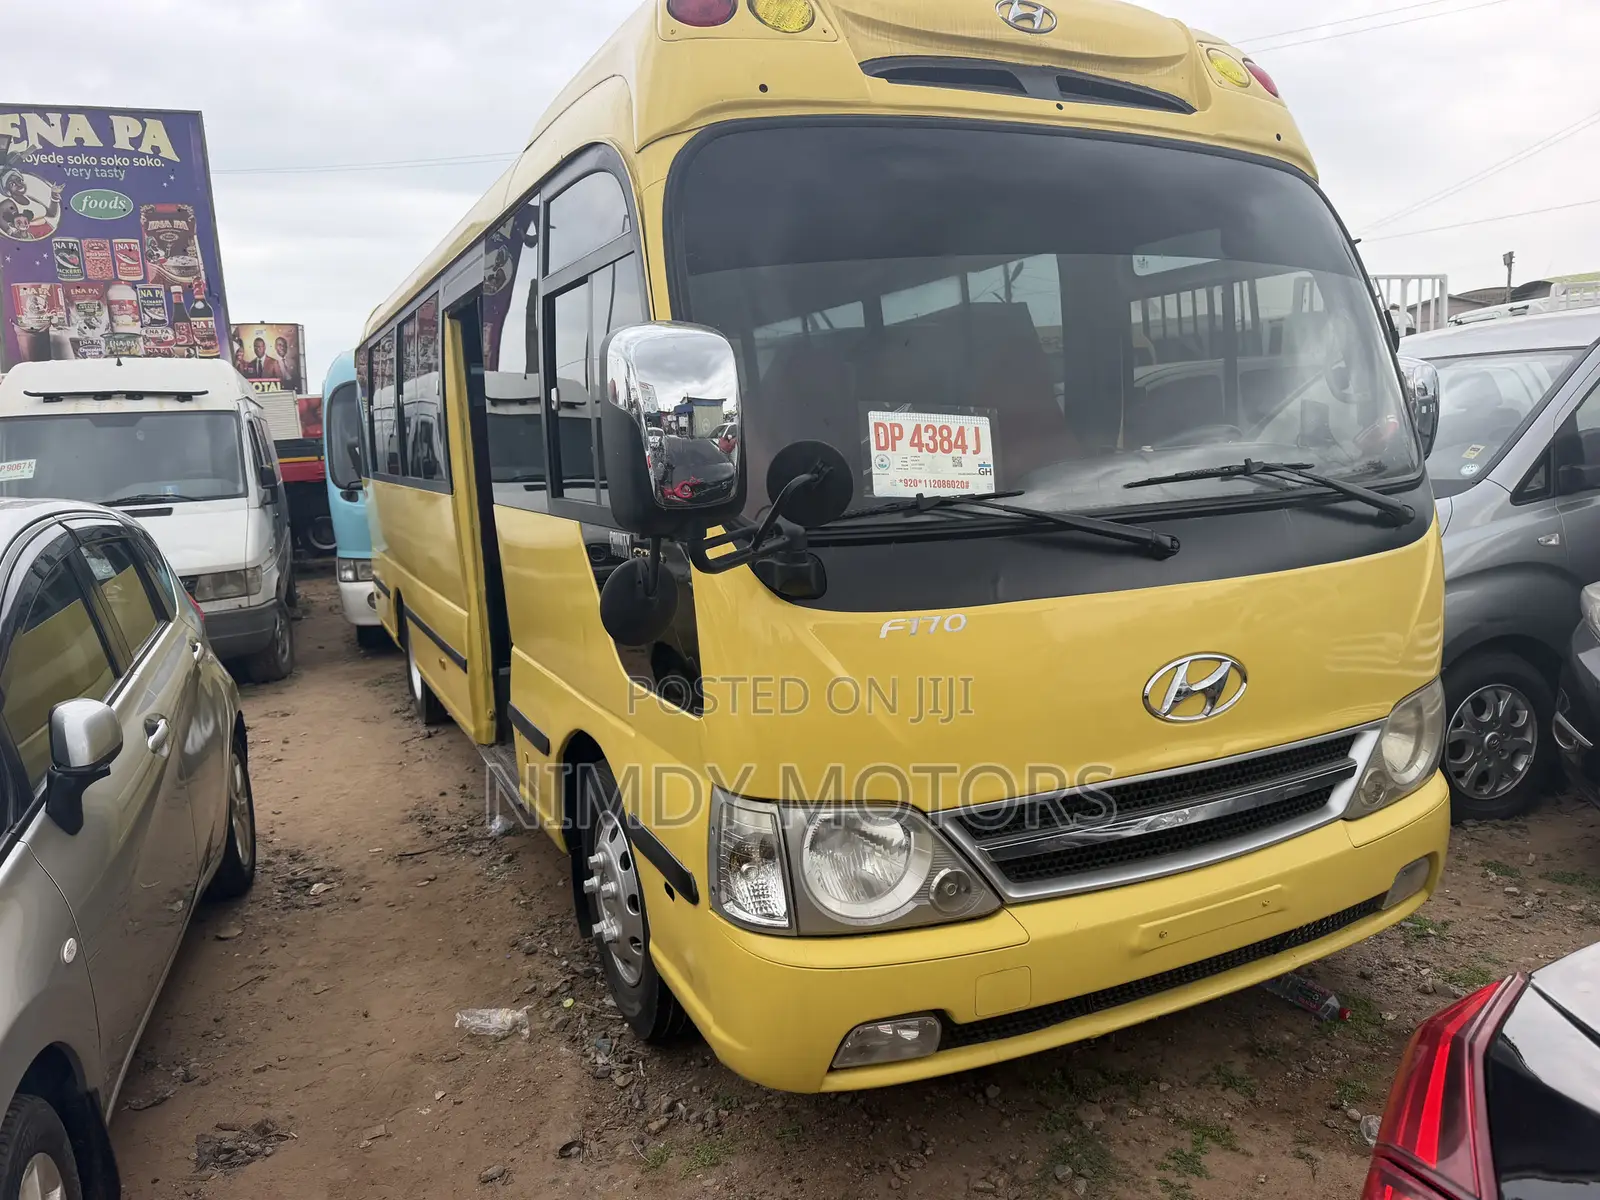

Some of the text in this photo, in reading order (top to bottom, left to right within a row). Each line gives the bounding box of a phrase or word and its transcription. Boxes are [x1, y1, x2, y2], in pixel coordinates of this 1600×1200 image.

[109, 115, 180, 162] PA
[67, 153, 97, 166] soko
[100, 154, 130, 167] soko
[133, 155, 165, 167] soko.
[63, 167, 126, 181] very tasty
[79, 195, 127, 212] foods
[68, 242, 79, 251] PA
[873, 422, 982, 455] DP 4384 J
[978, 467, 993, 476] GH
[879, 613, 968, 639] F170
